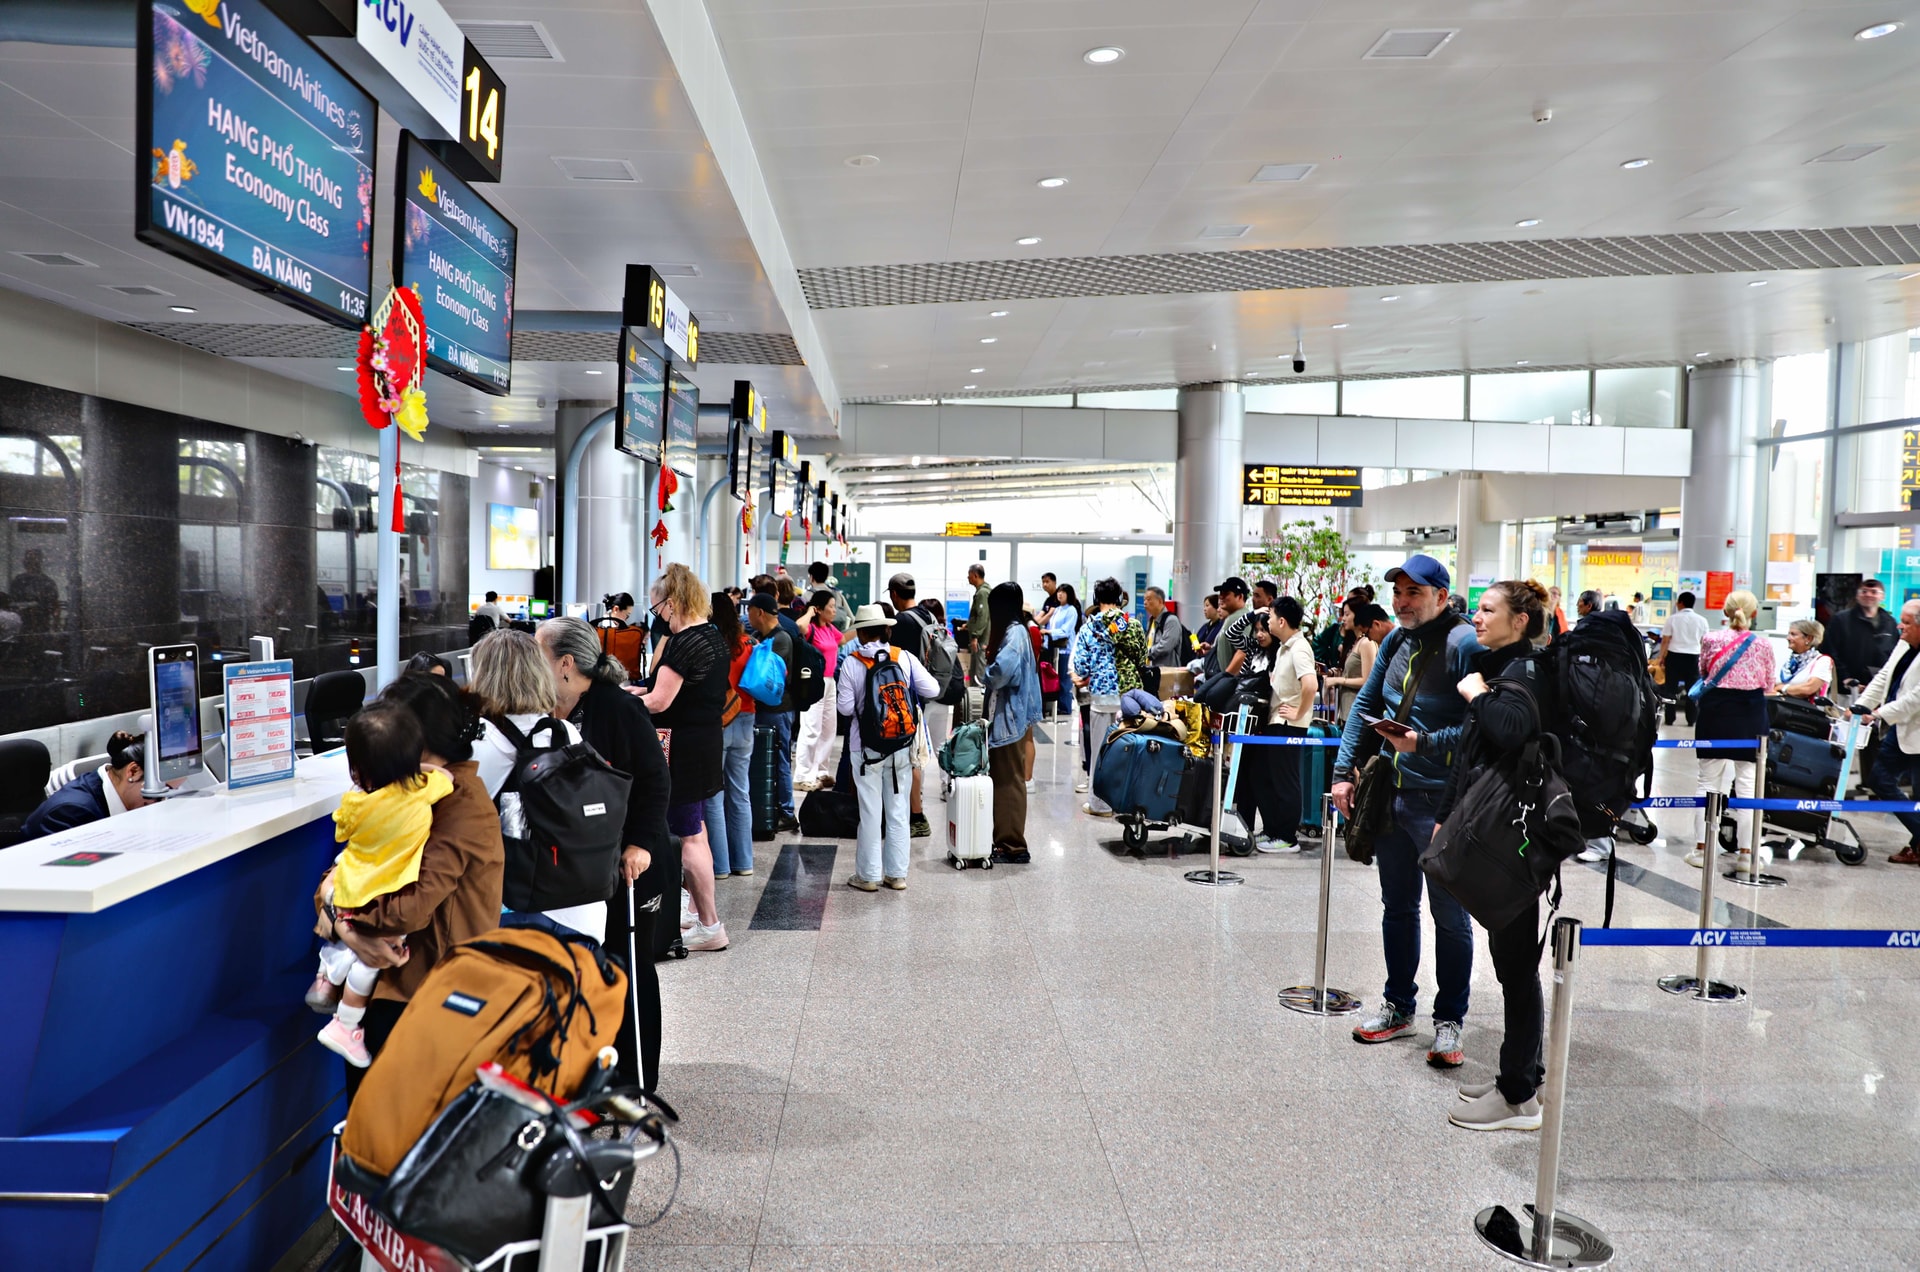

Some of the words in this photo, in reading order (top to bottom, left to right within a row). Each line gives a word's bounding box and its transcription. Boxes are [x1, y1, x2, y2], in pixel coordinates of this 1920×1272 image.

[466, 66, 498, 160] 14
[208, 97, 259, 155] HẠNG
[261, 134, 295, 177] PHỔ
[296, 157, 342, 209] THÔNG
[226, 152, 295, 222] Economy
[297, 198, 330, 238] Class
[163, 200, 225, 252] VN1954
[252, 245, 272, 276] ĐÀ
[428, 250, 454, 280] HẠNG
[472, 280, 497, 311] THÔNG
[340, 290, 366, 318] 11:35
[436, 285, 471, 325] Economy
[471, 308, 489, 333] Class
[649, 279, 664, 329] 15
[447, 344, 459, 364] ĐÀ
[687, 320, 699, 363] 16
[493, 368, 508, 388] 11:35
[1286, 737, 1303, 745] ACV
[1650, 798, 1673, 807] ACV
[1796, 800, 1819, 810] ACV
[1690, 930, 1727, 946] ACV
